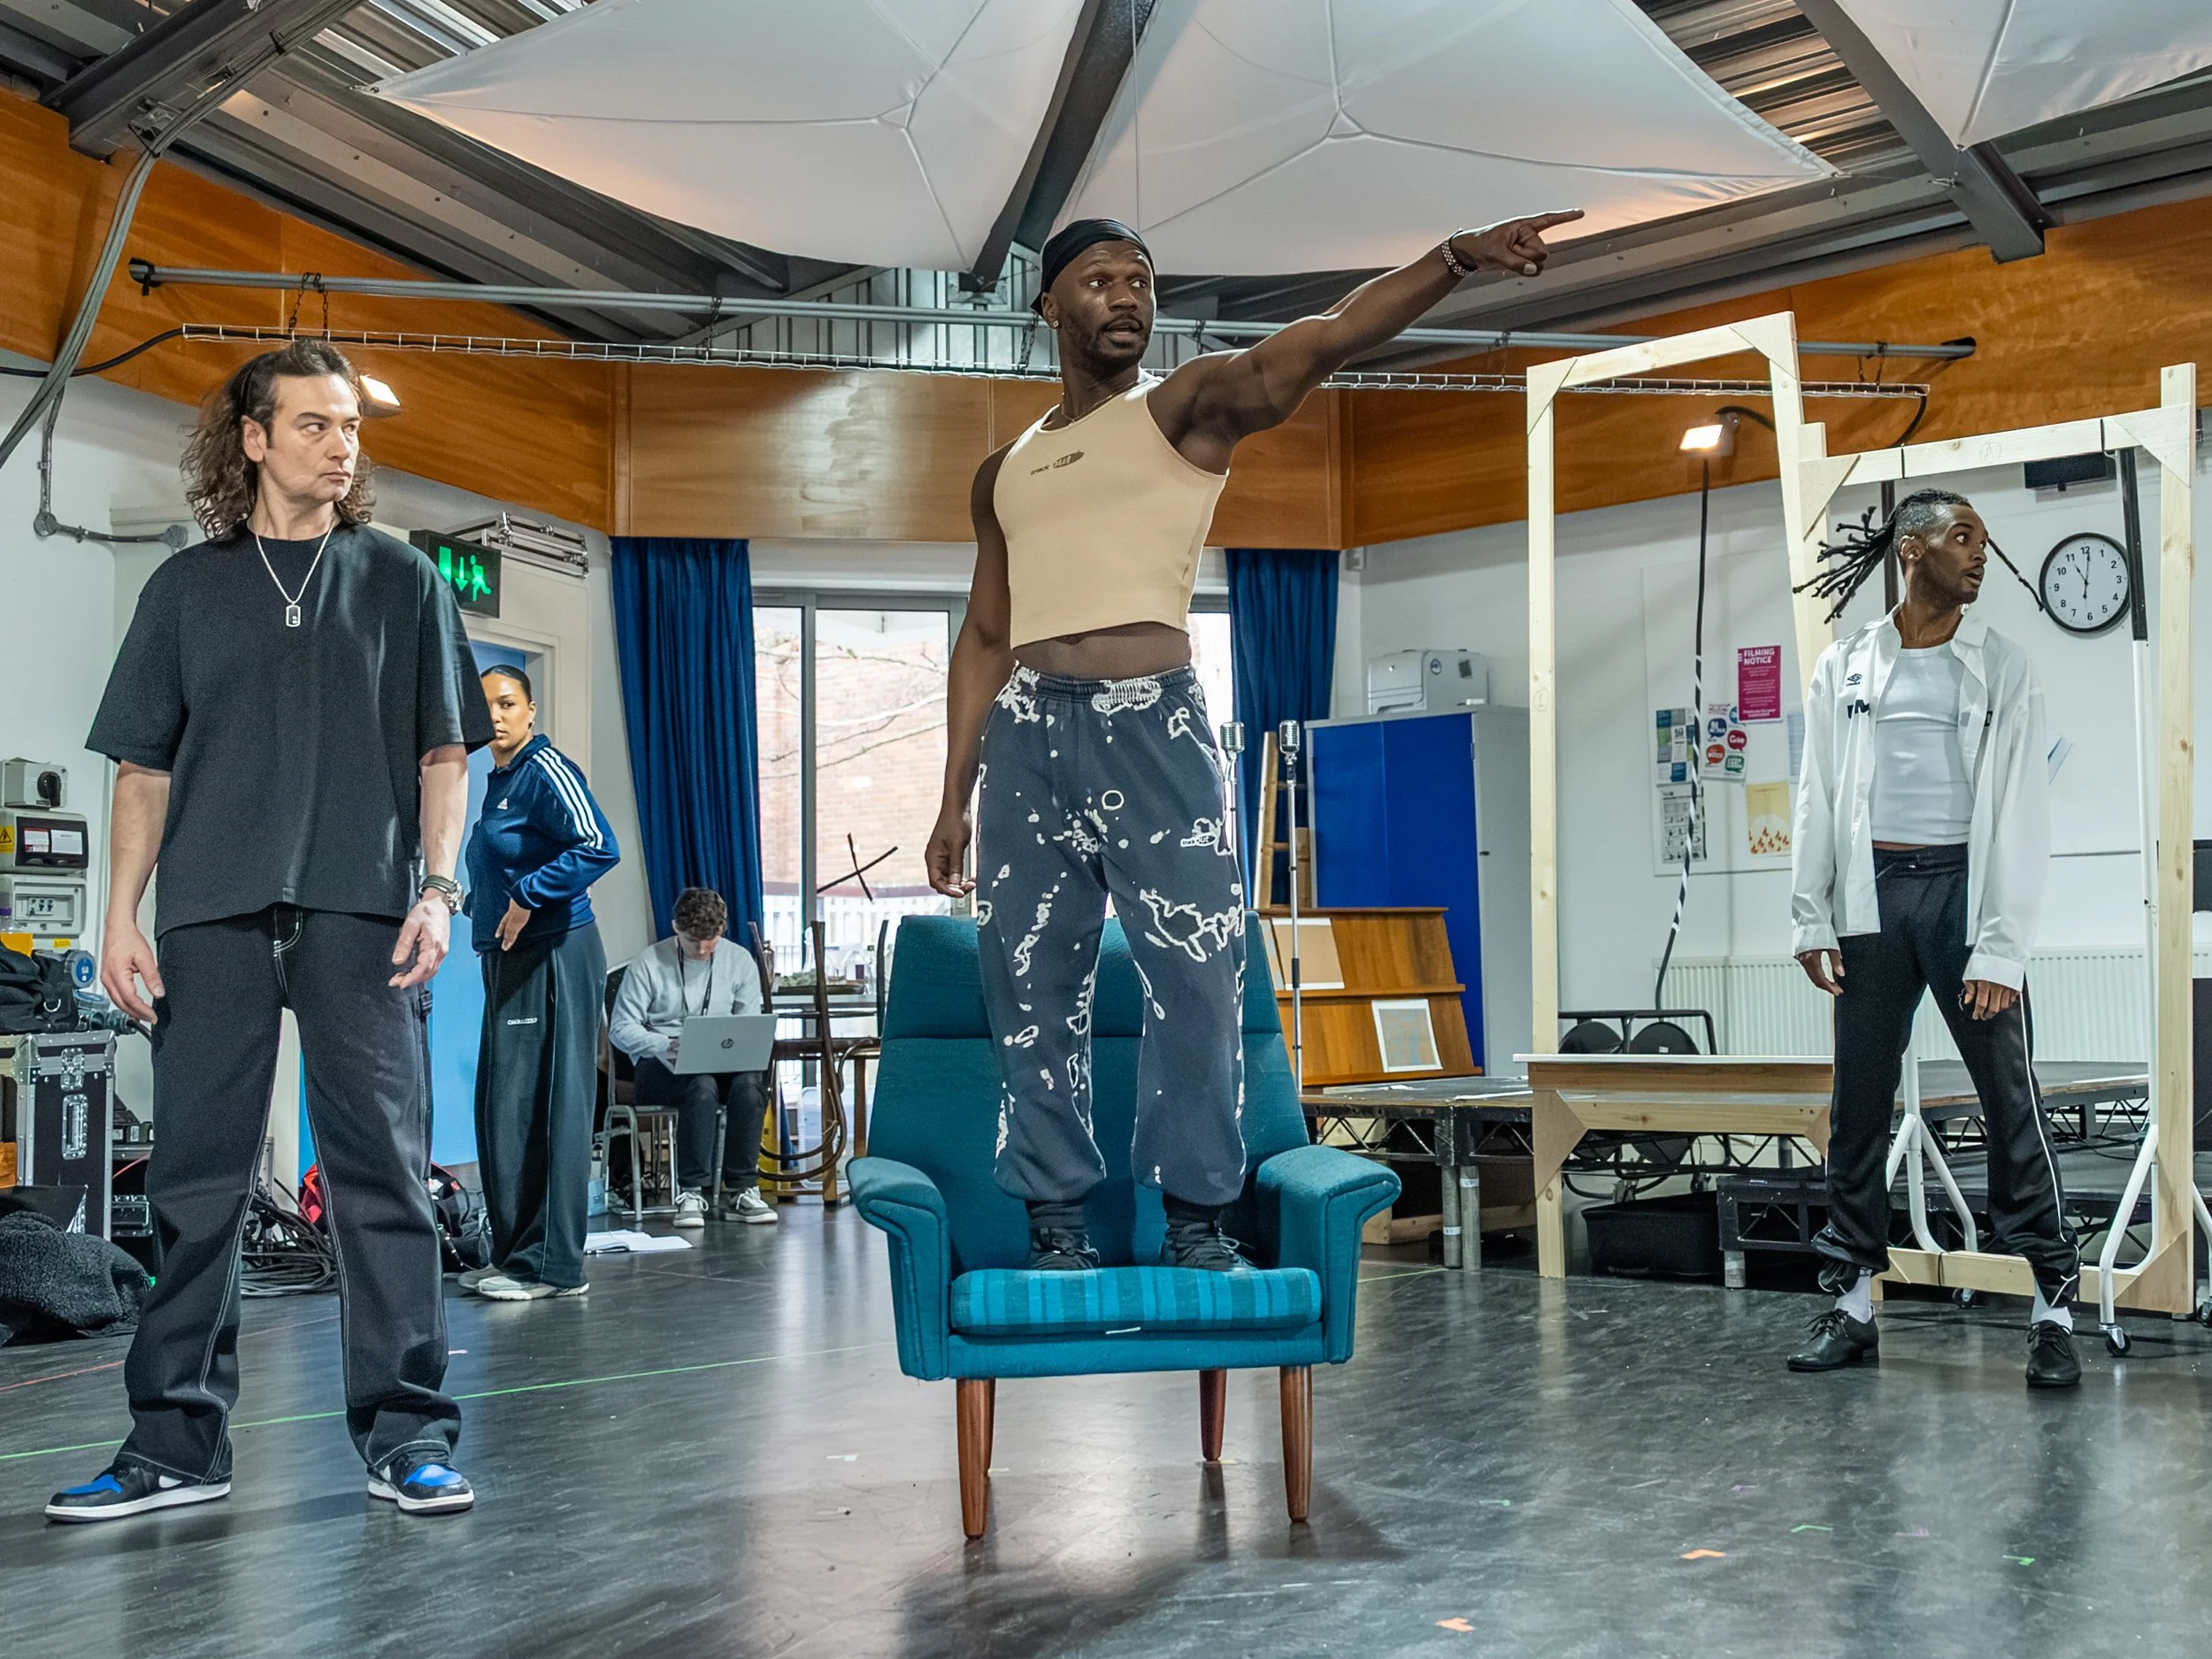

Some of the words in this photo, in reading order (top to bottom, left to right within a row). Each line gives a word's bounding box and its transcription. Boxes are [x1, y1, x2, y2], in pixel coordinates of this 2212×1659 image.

[2080, 546, 2091, 555] 12
[2110, 560, 2116, 569] 2
[2116, 575, 2122, 584] 3
[2054, 583, 2060, 592] 9
[2102, 604, 2108, 613] 5
[1744, 648, 1775, 657] FILMING
[1744, 657, 1772, 665] NOTICE
